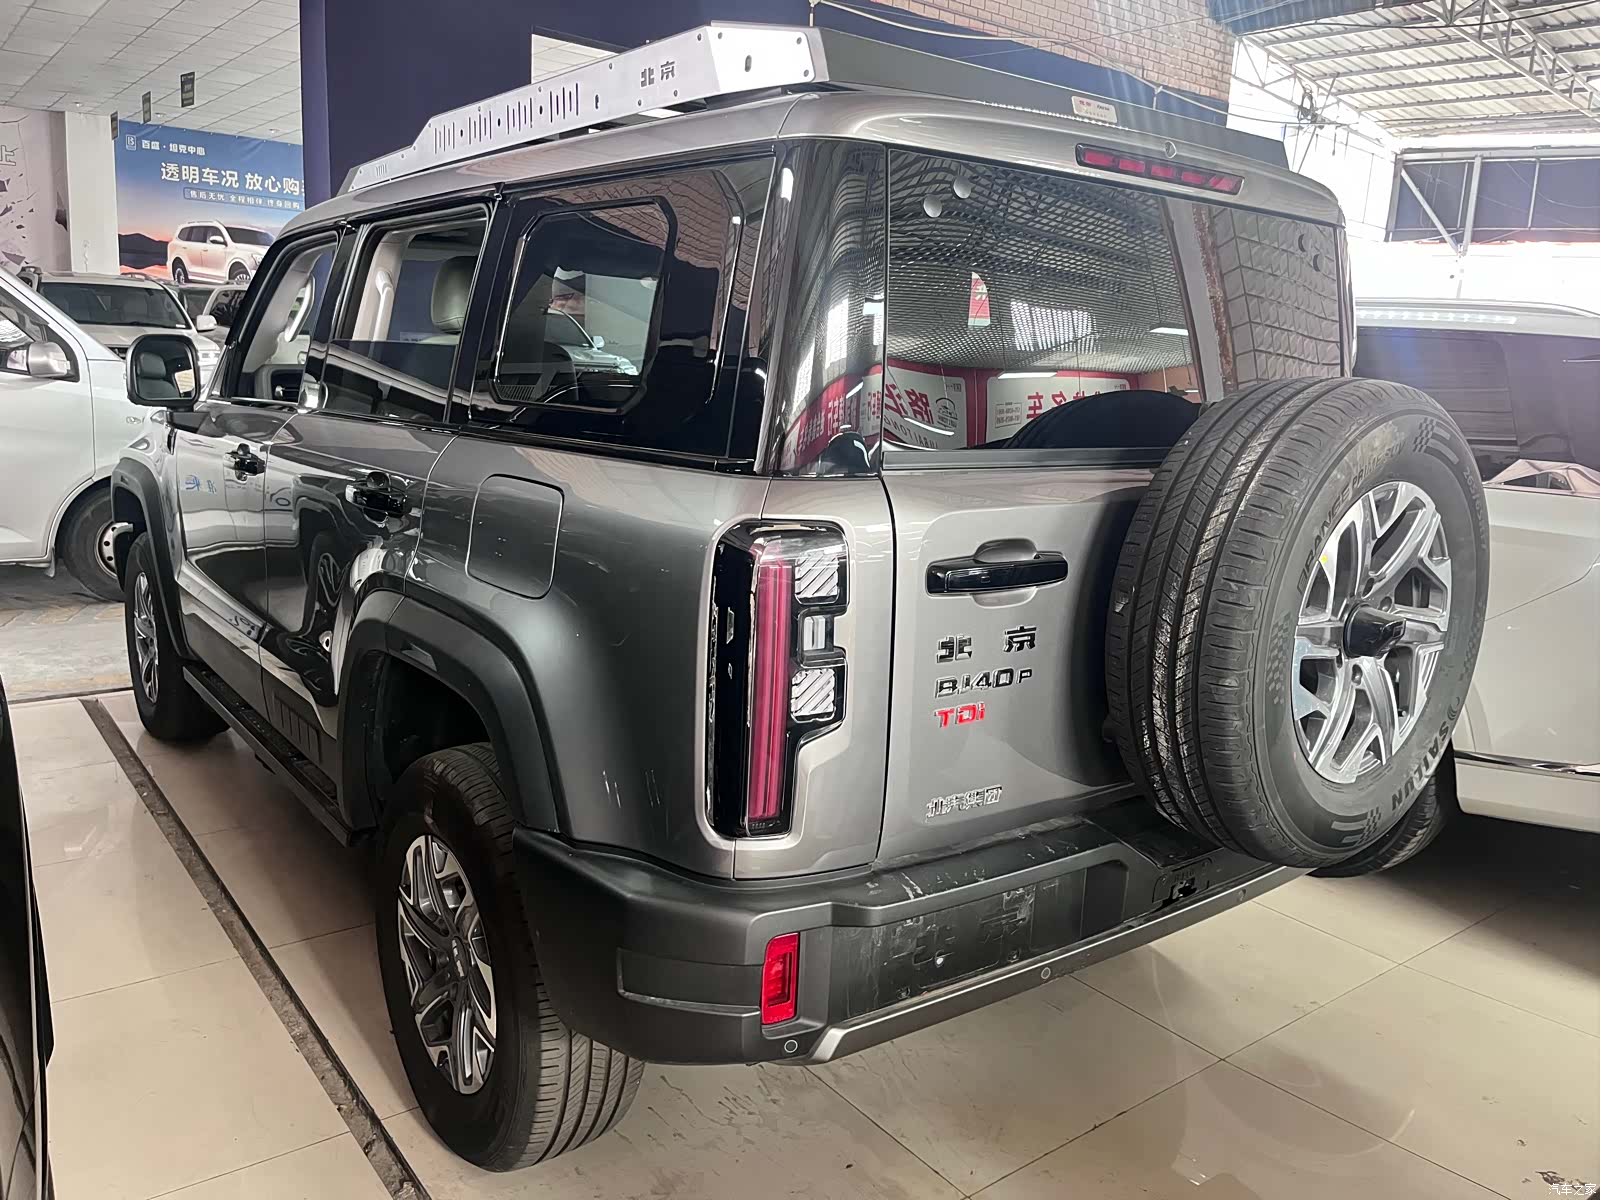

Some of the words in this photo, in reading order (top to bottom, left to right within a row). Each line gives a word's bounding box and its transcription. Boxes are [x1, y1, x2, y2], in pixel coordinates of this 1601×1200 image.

[640, 60, 676, 88] 北京
[160, 161, 240, 188] 透明车况
[244, 172, 305, 196] 放心购
[936, 625, 1037, 664] 北京
[1391, 719, 1450, 812] SAILUN
